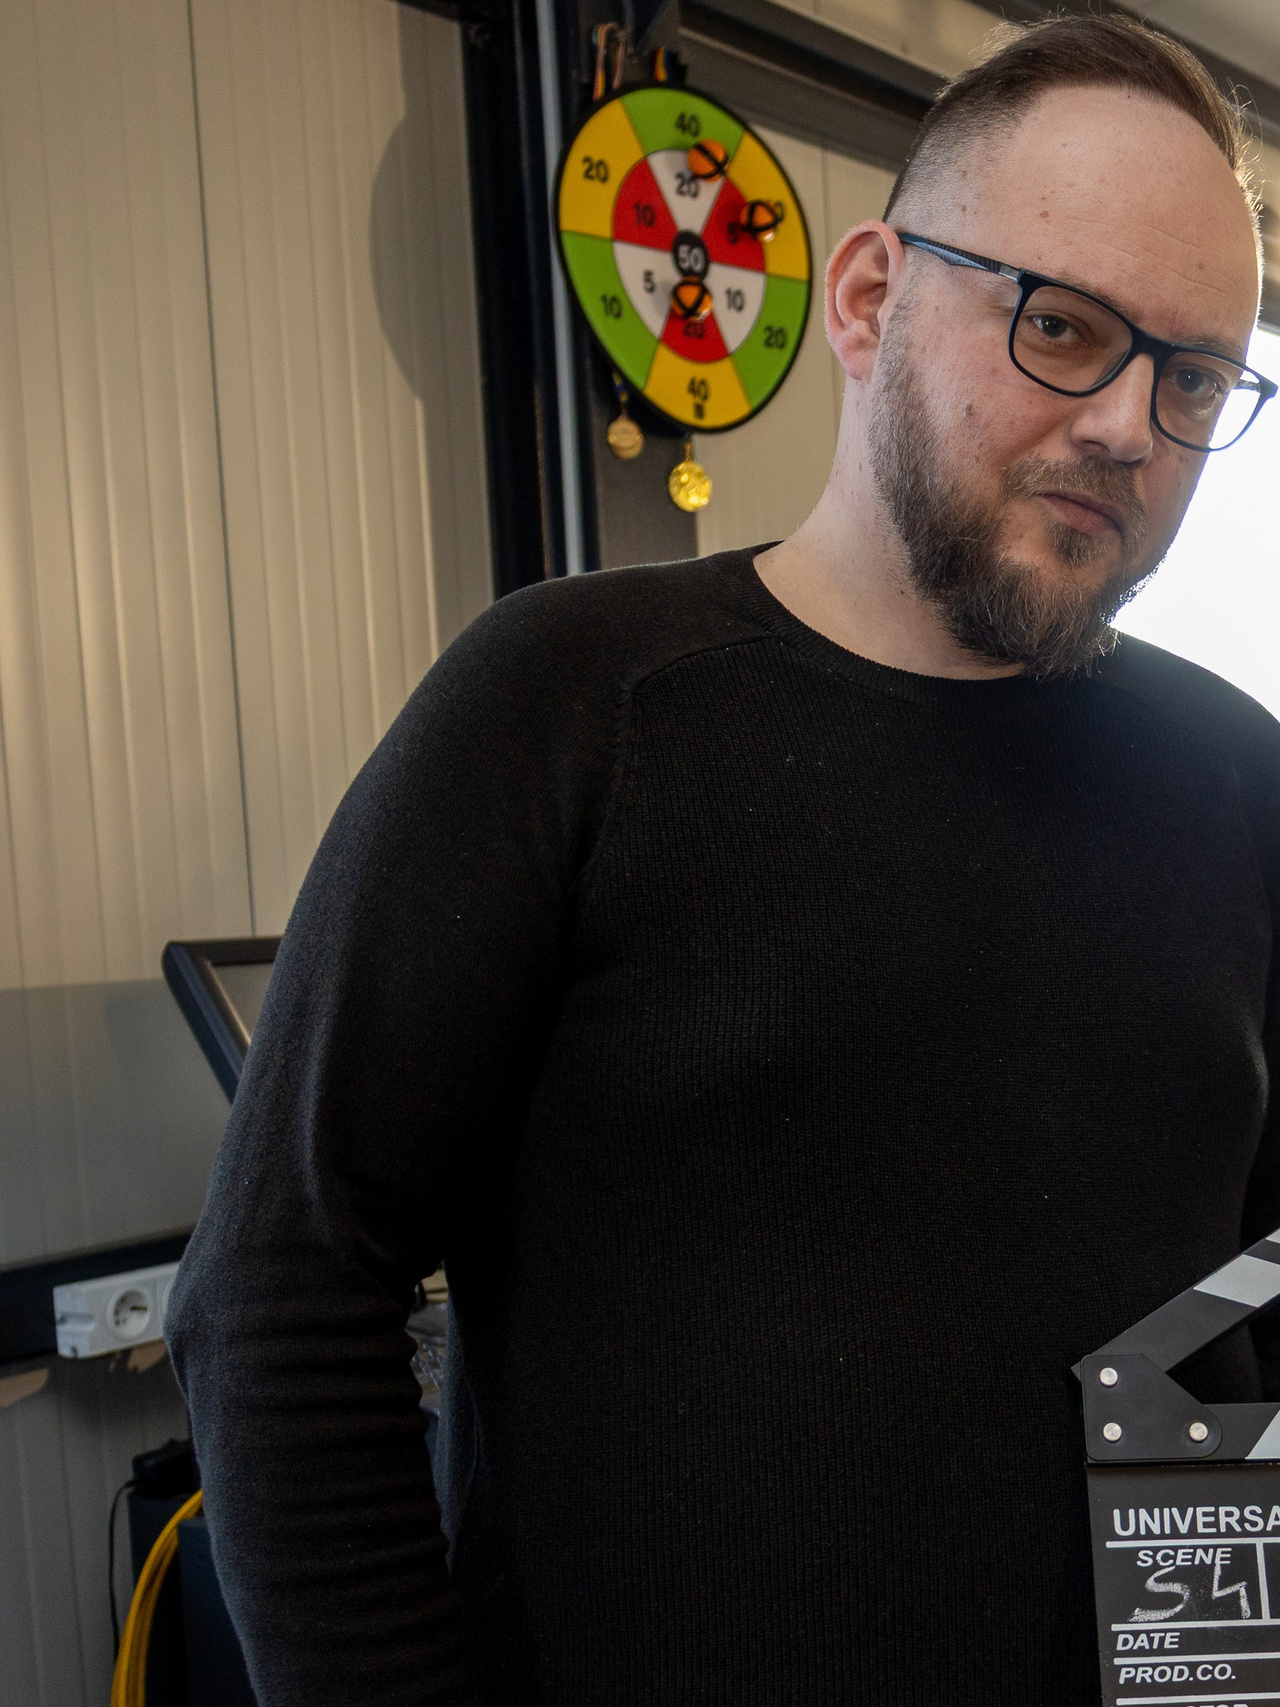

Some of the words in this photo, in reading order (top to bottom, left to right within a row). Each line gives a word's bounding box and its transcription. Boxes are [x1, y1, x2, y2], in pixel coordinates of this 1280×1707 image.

[675, 112, 702, 138] 40
[582, 156, 609, 184] 20
[675, 172, 700, 199] 20
[633, 202, 656, 228] 10
[677, 244, 701, 272] 50
[643, 270, 656, 294] 5
[601, 294, 623, 319] 10
[725, 287, 745, 312] 10
[763, 325, 787, 349] 20
[687, 376, 710, 402] 40
[1136, 1547, 1233, 1568] SCENE
[1115, 1632, 1181, 1651] DATE
[1118, 1663, 1238, 1685] PROD.CO.
